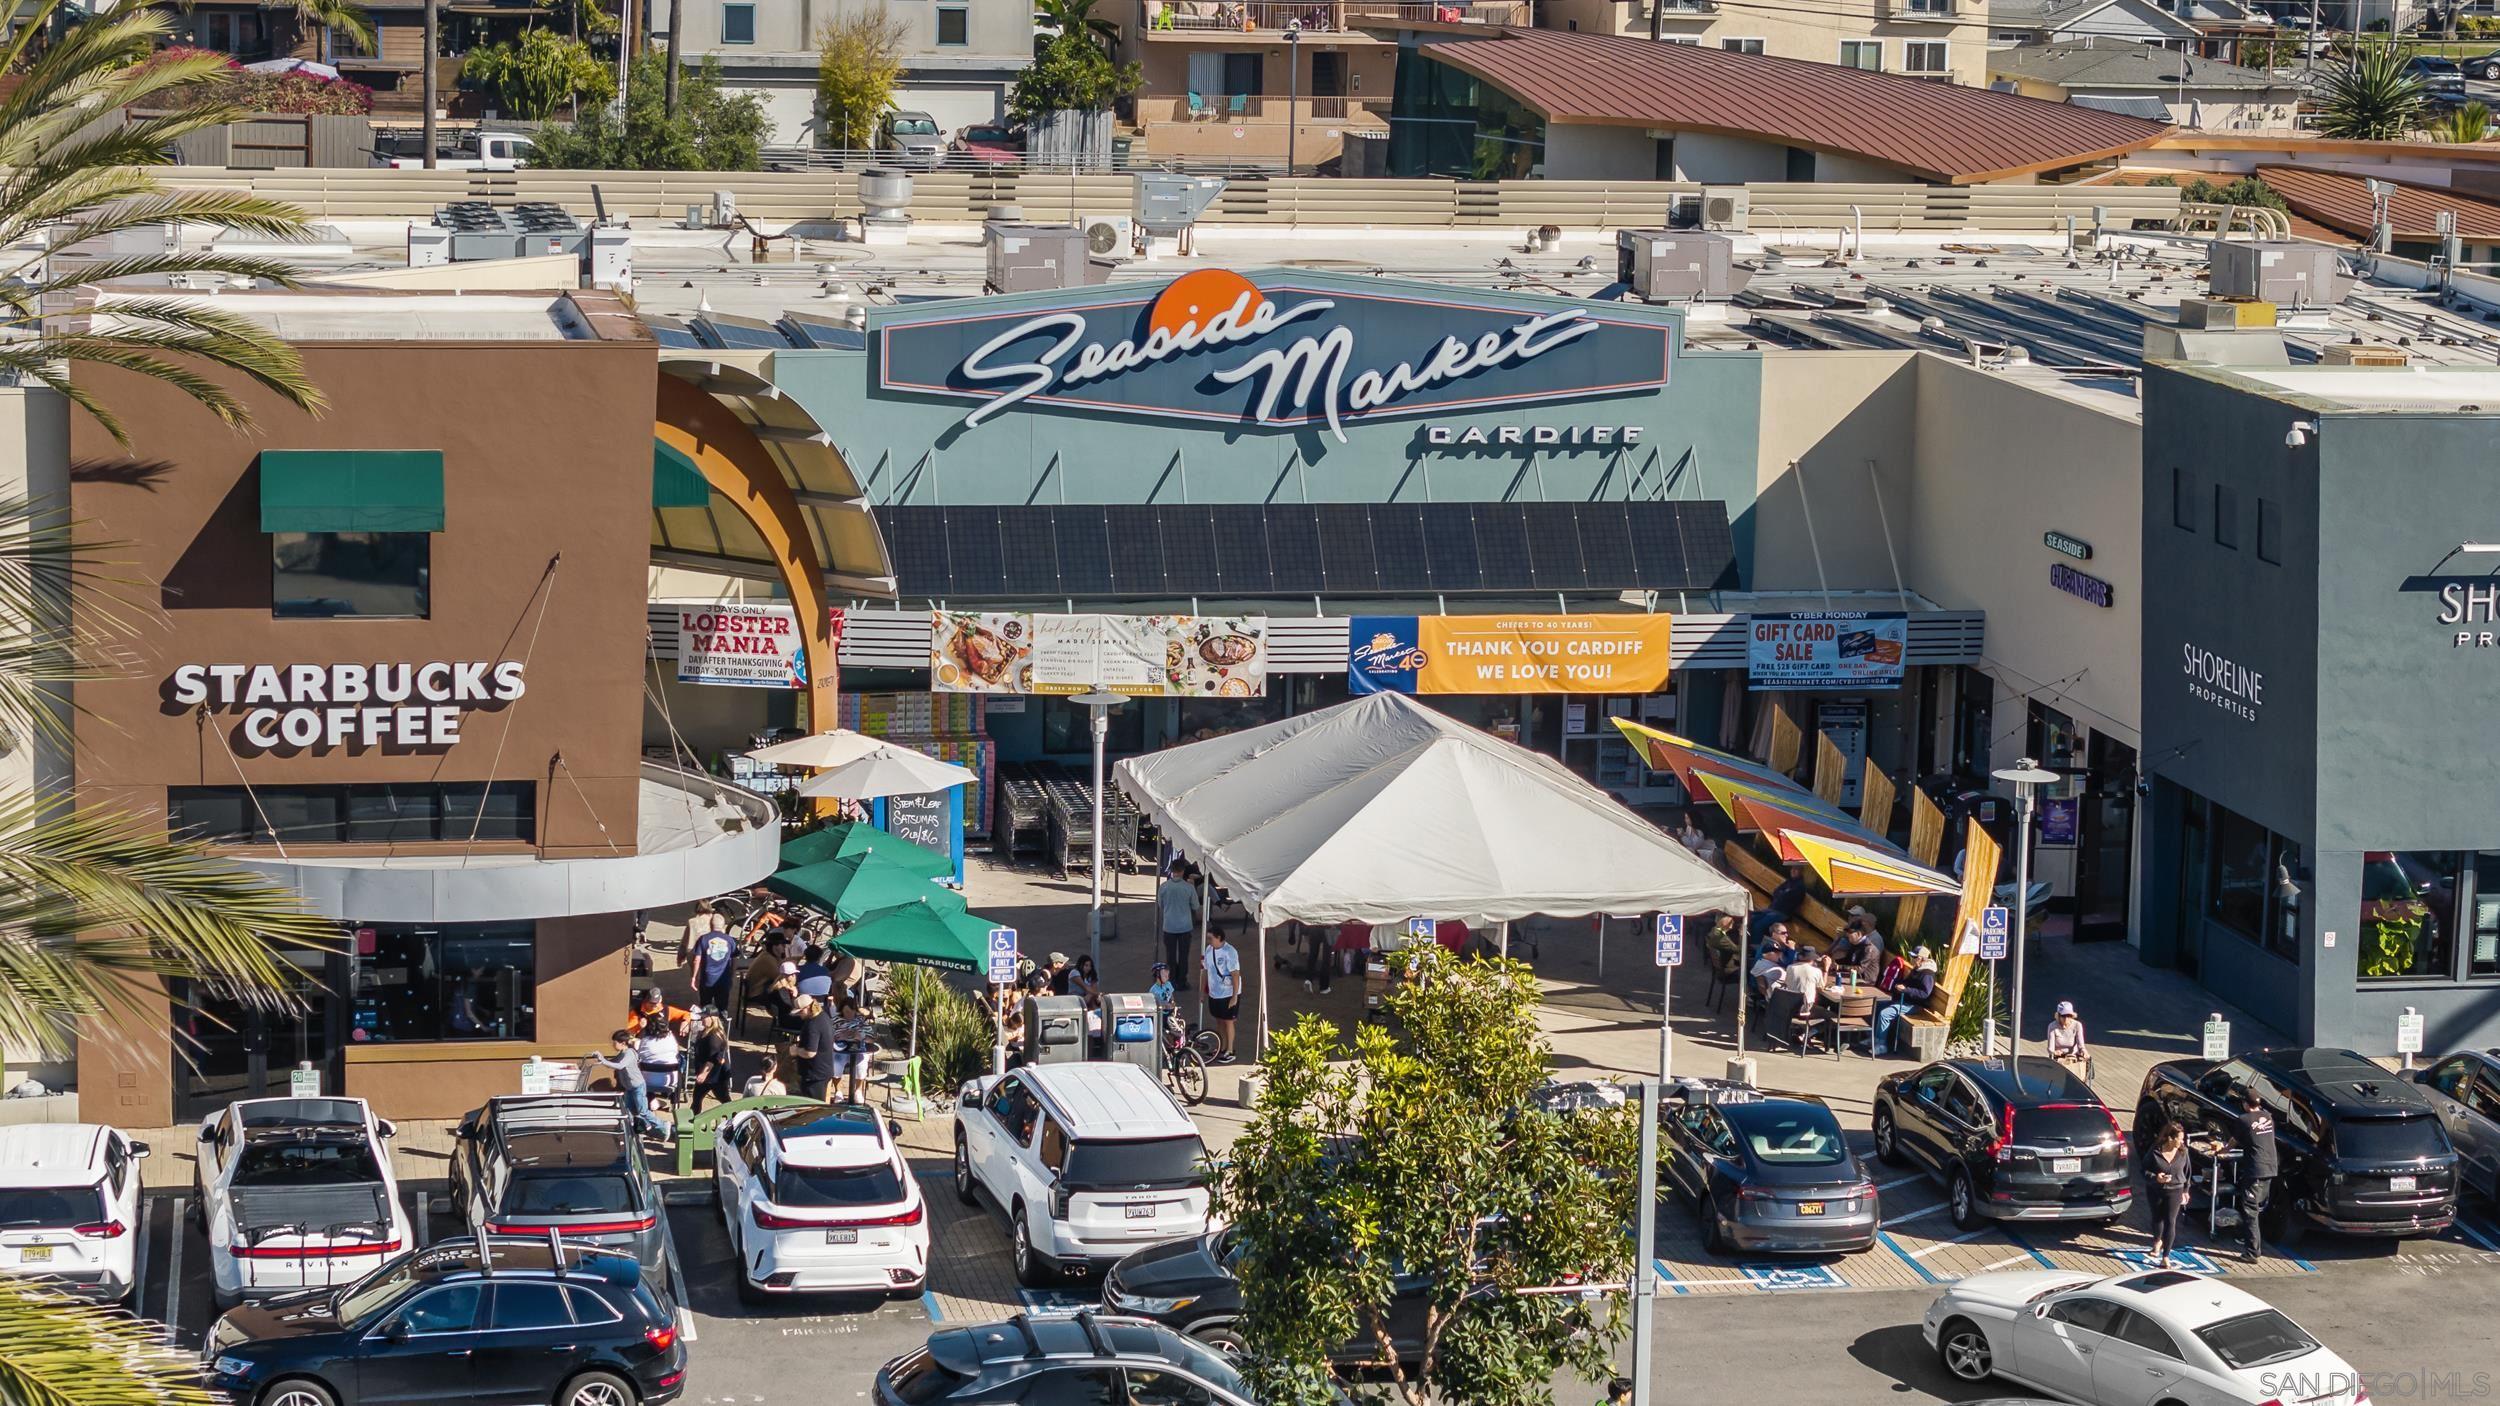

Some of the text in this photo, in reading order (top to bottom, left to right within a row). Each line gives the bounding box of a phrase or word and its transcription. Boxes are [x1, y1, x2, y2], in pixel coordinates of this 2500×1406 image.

[963, 290, 1334, 429] Seaside
[1214, 309, 1599, 444] Market
[1427, 426, 1645, 445] CARDIFF
[2046, 534, 2084, 557] SEASIDE
[2050, 563, 2107, 607] CLEANERS
[714, 606, 740, 614] DAYS
[741, 607, 768, 615] ONLY
[2441, 583, 2500, 623] SH
[1790, 611, 1868, 620] CYBER MONDAY
[682, 613, 790, 635] LOBSTER
[1496, 621, 1593, 629] CHEERS TO 40 YEARS!
[1755, 623, 1836, 642] GIFT CARD
[2458, 632, 2500, 646] PR
[692, 634, 779, 655] MANIA
[1446, 640, 1644, 656] THANK YOU CARDIFF
[1775, 643, 1814, 661] SALE
[688, 655, 783, 668] DAY AFTER THANKSGIVING
[1399, 650, 1428, 671] 40
[683, 665, 710, 675] FRIDAY
[714, 667, 752, 677] SATURDAY
[758, 669, 788, 678] SUNDAY
[1476, 664, 1612, 680] WE LOVE YOU!
[2184, 642, 2263, 705] SHORELINE
[175, 661, 526, 705] STARBUCKS
[2189, 682, 2256, 721] PROPERTIES
[244, 706, 461, 748] COFFEE
[1658, 934, 1681, 942] PARKING
[1983, 927, 2005, 936] PARKING
[1987, 935, 2001, 943] ONLY
[991, 950, 1015, 958] PARKING
[1662, 942, 1676, 950] ONLY
[917, 957, 972, 971] STARBUCKS
[995, 959, 1010, 967] ONLY
[2206, 1023, 2215, 1033] 20
[293, 1072, 303, 1082] 20
[523, 1065, 533, 1076] 20
